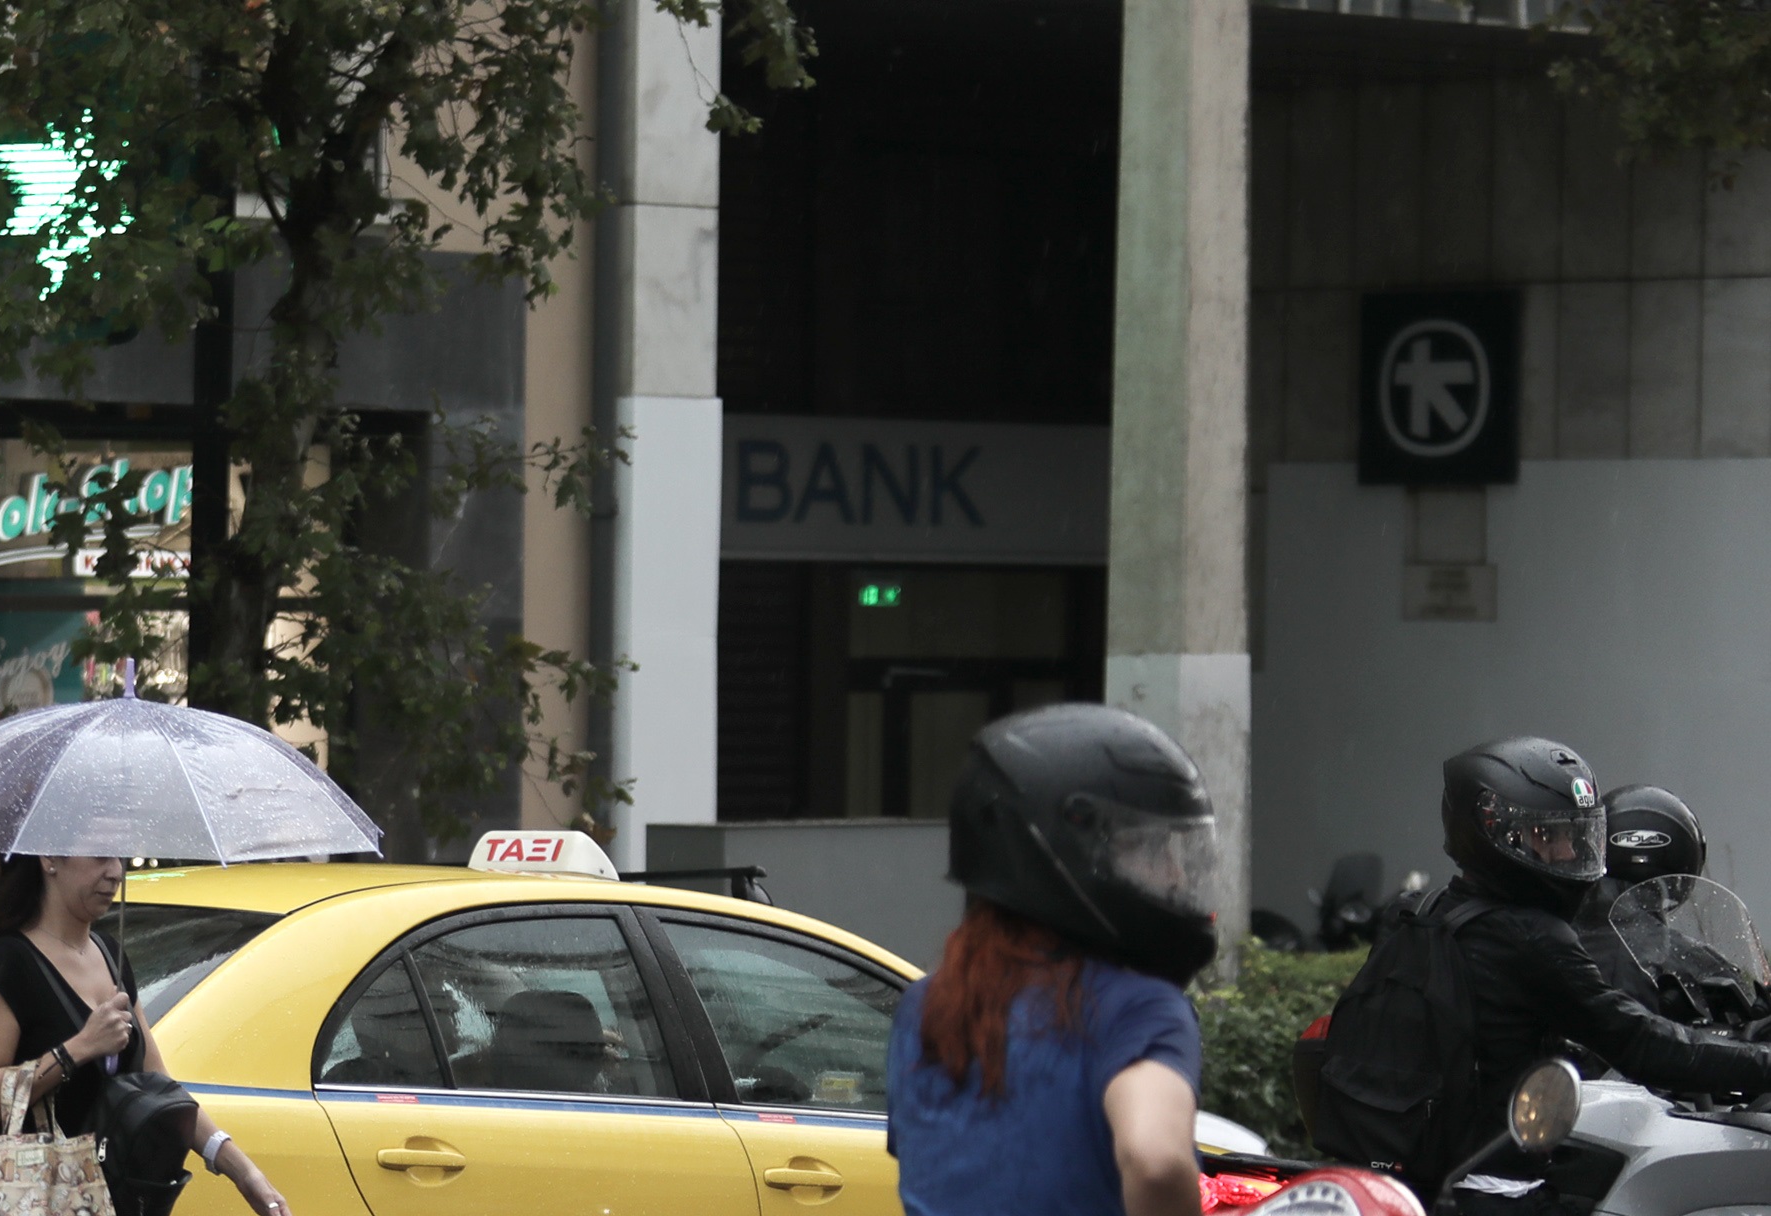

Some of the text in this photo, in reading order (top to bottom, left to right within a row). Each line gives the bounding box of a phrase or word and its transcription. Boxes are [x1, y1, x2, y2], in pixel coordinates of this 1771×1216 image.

[736, 440, 986, 528] BANK
[1578, 794, 1594, 808] agv
[485, 838, 565, 862] ΤΑΞΙ
[1370, 1161, 1395, 1170] CITY
